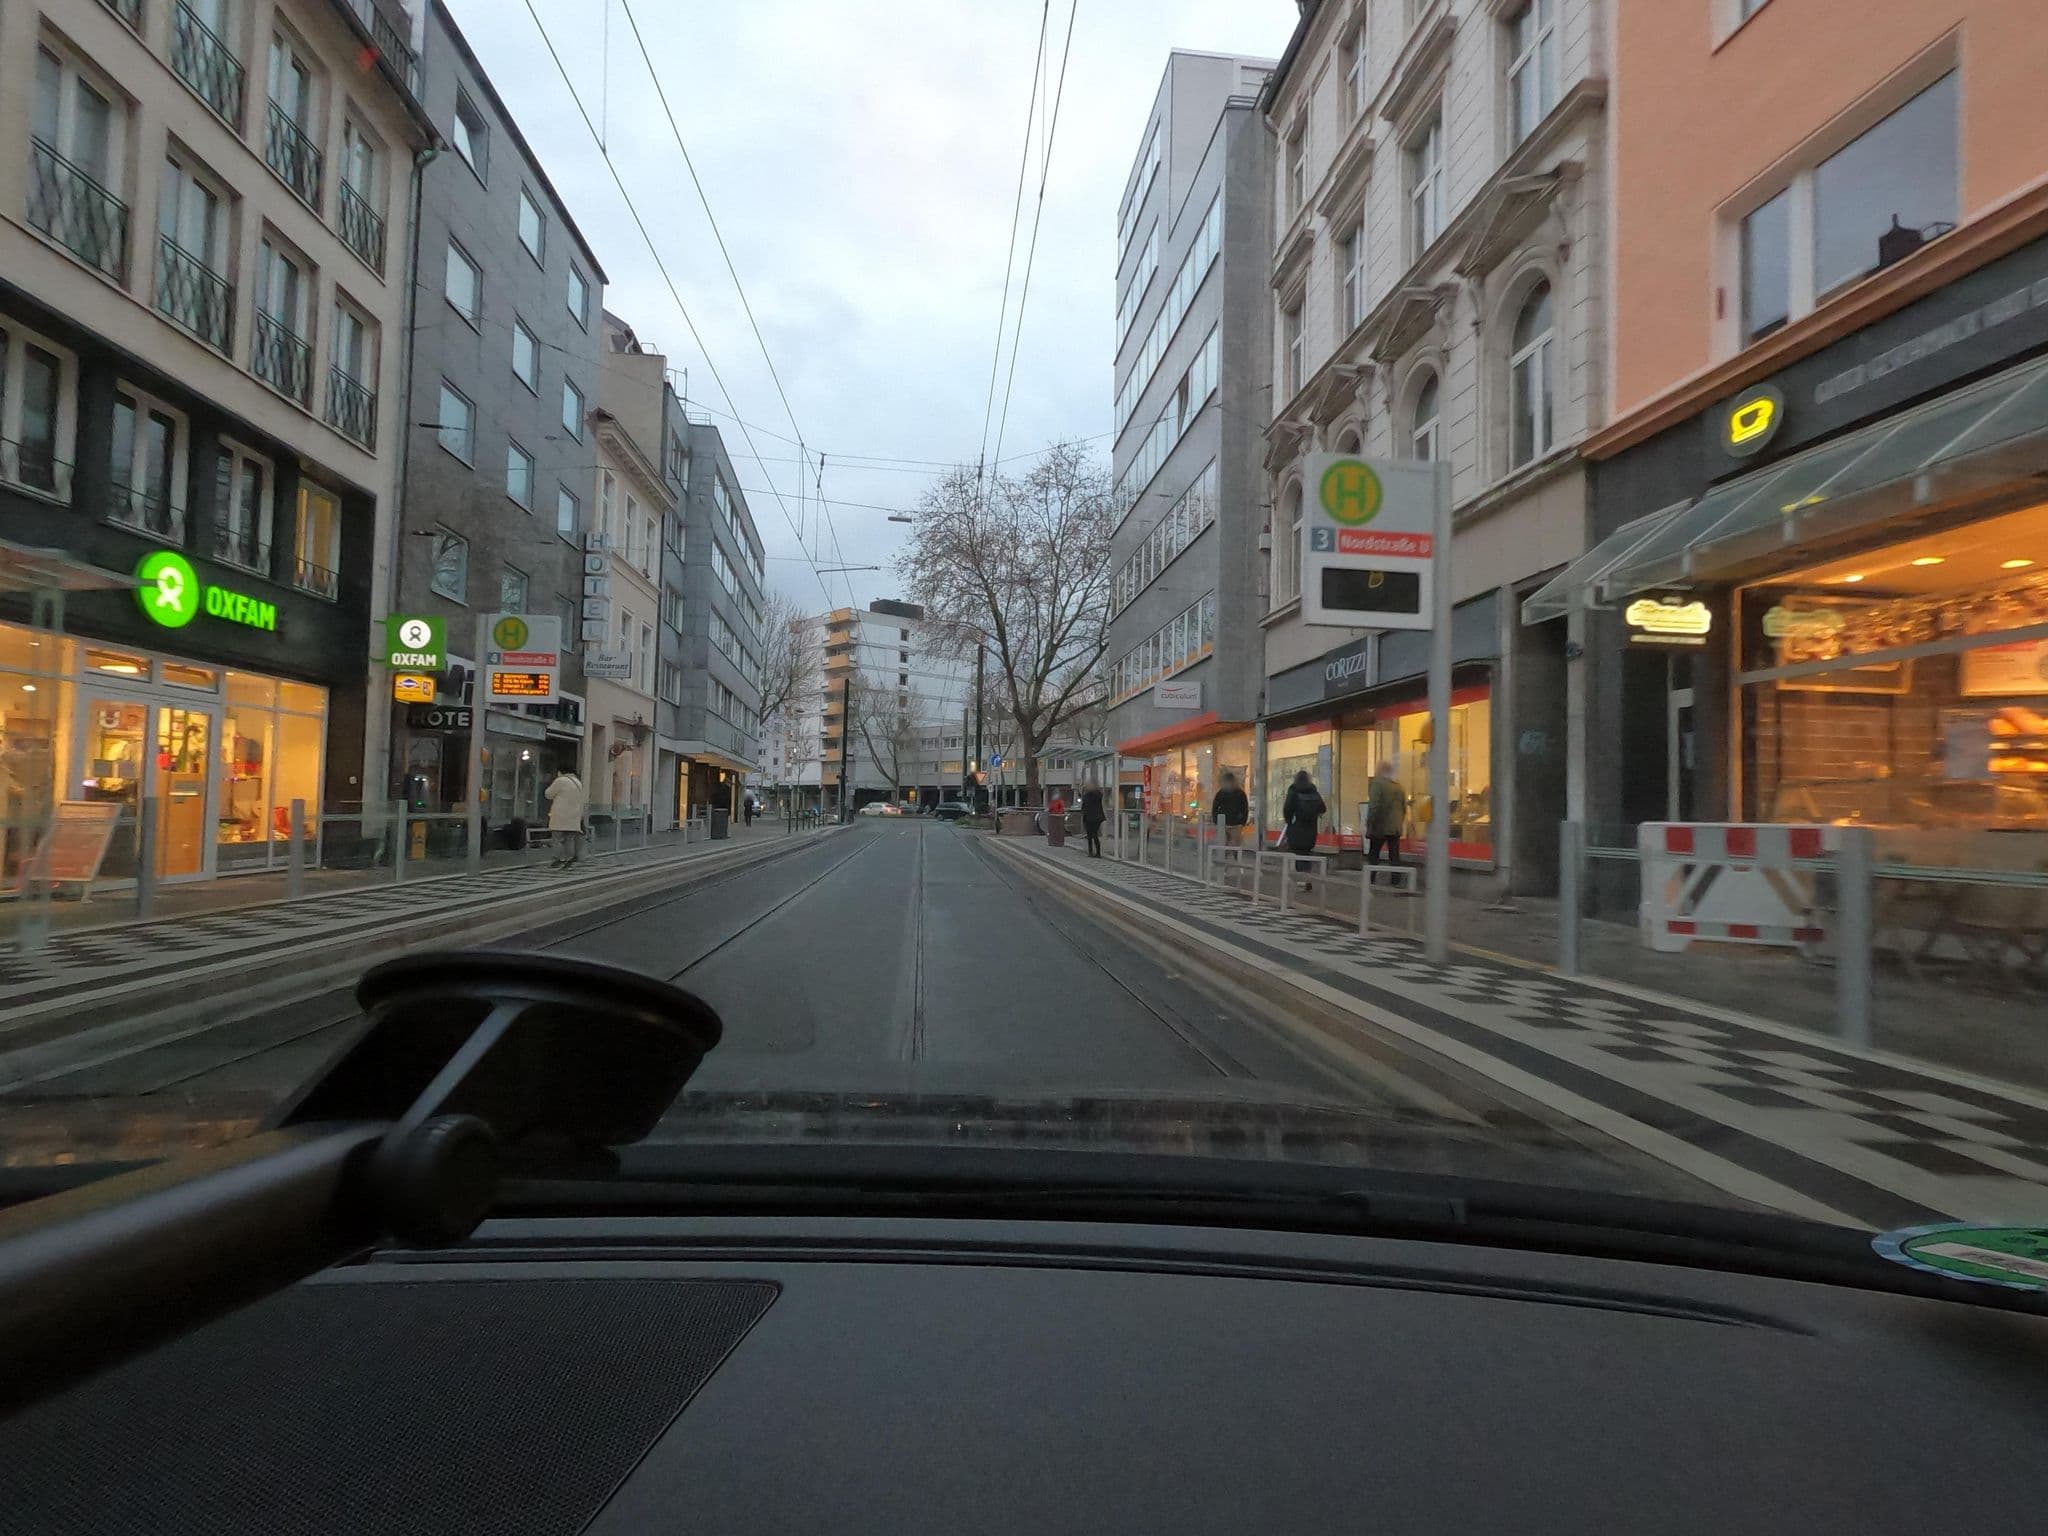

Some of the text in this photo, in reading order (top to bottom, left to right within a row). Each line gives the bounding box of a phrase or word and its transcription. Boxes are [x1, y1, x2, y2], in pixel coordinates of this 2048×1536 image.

[1336, 472, 1367, 512] H
[1316, 528, 1330, 550] 3
[588, 533, 605, 638] HOTEL
[206, 585, 276, 632] OXFAM
[391, 652, 437, 667] OXFAM
[490, 652, 499, 664] 4
[1325, 651, 1366, 681] CORIZZI
